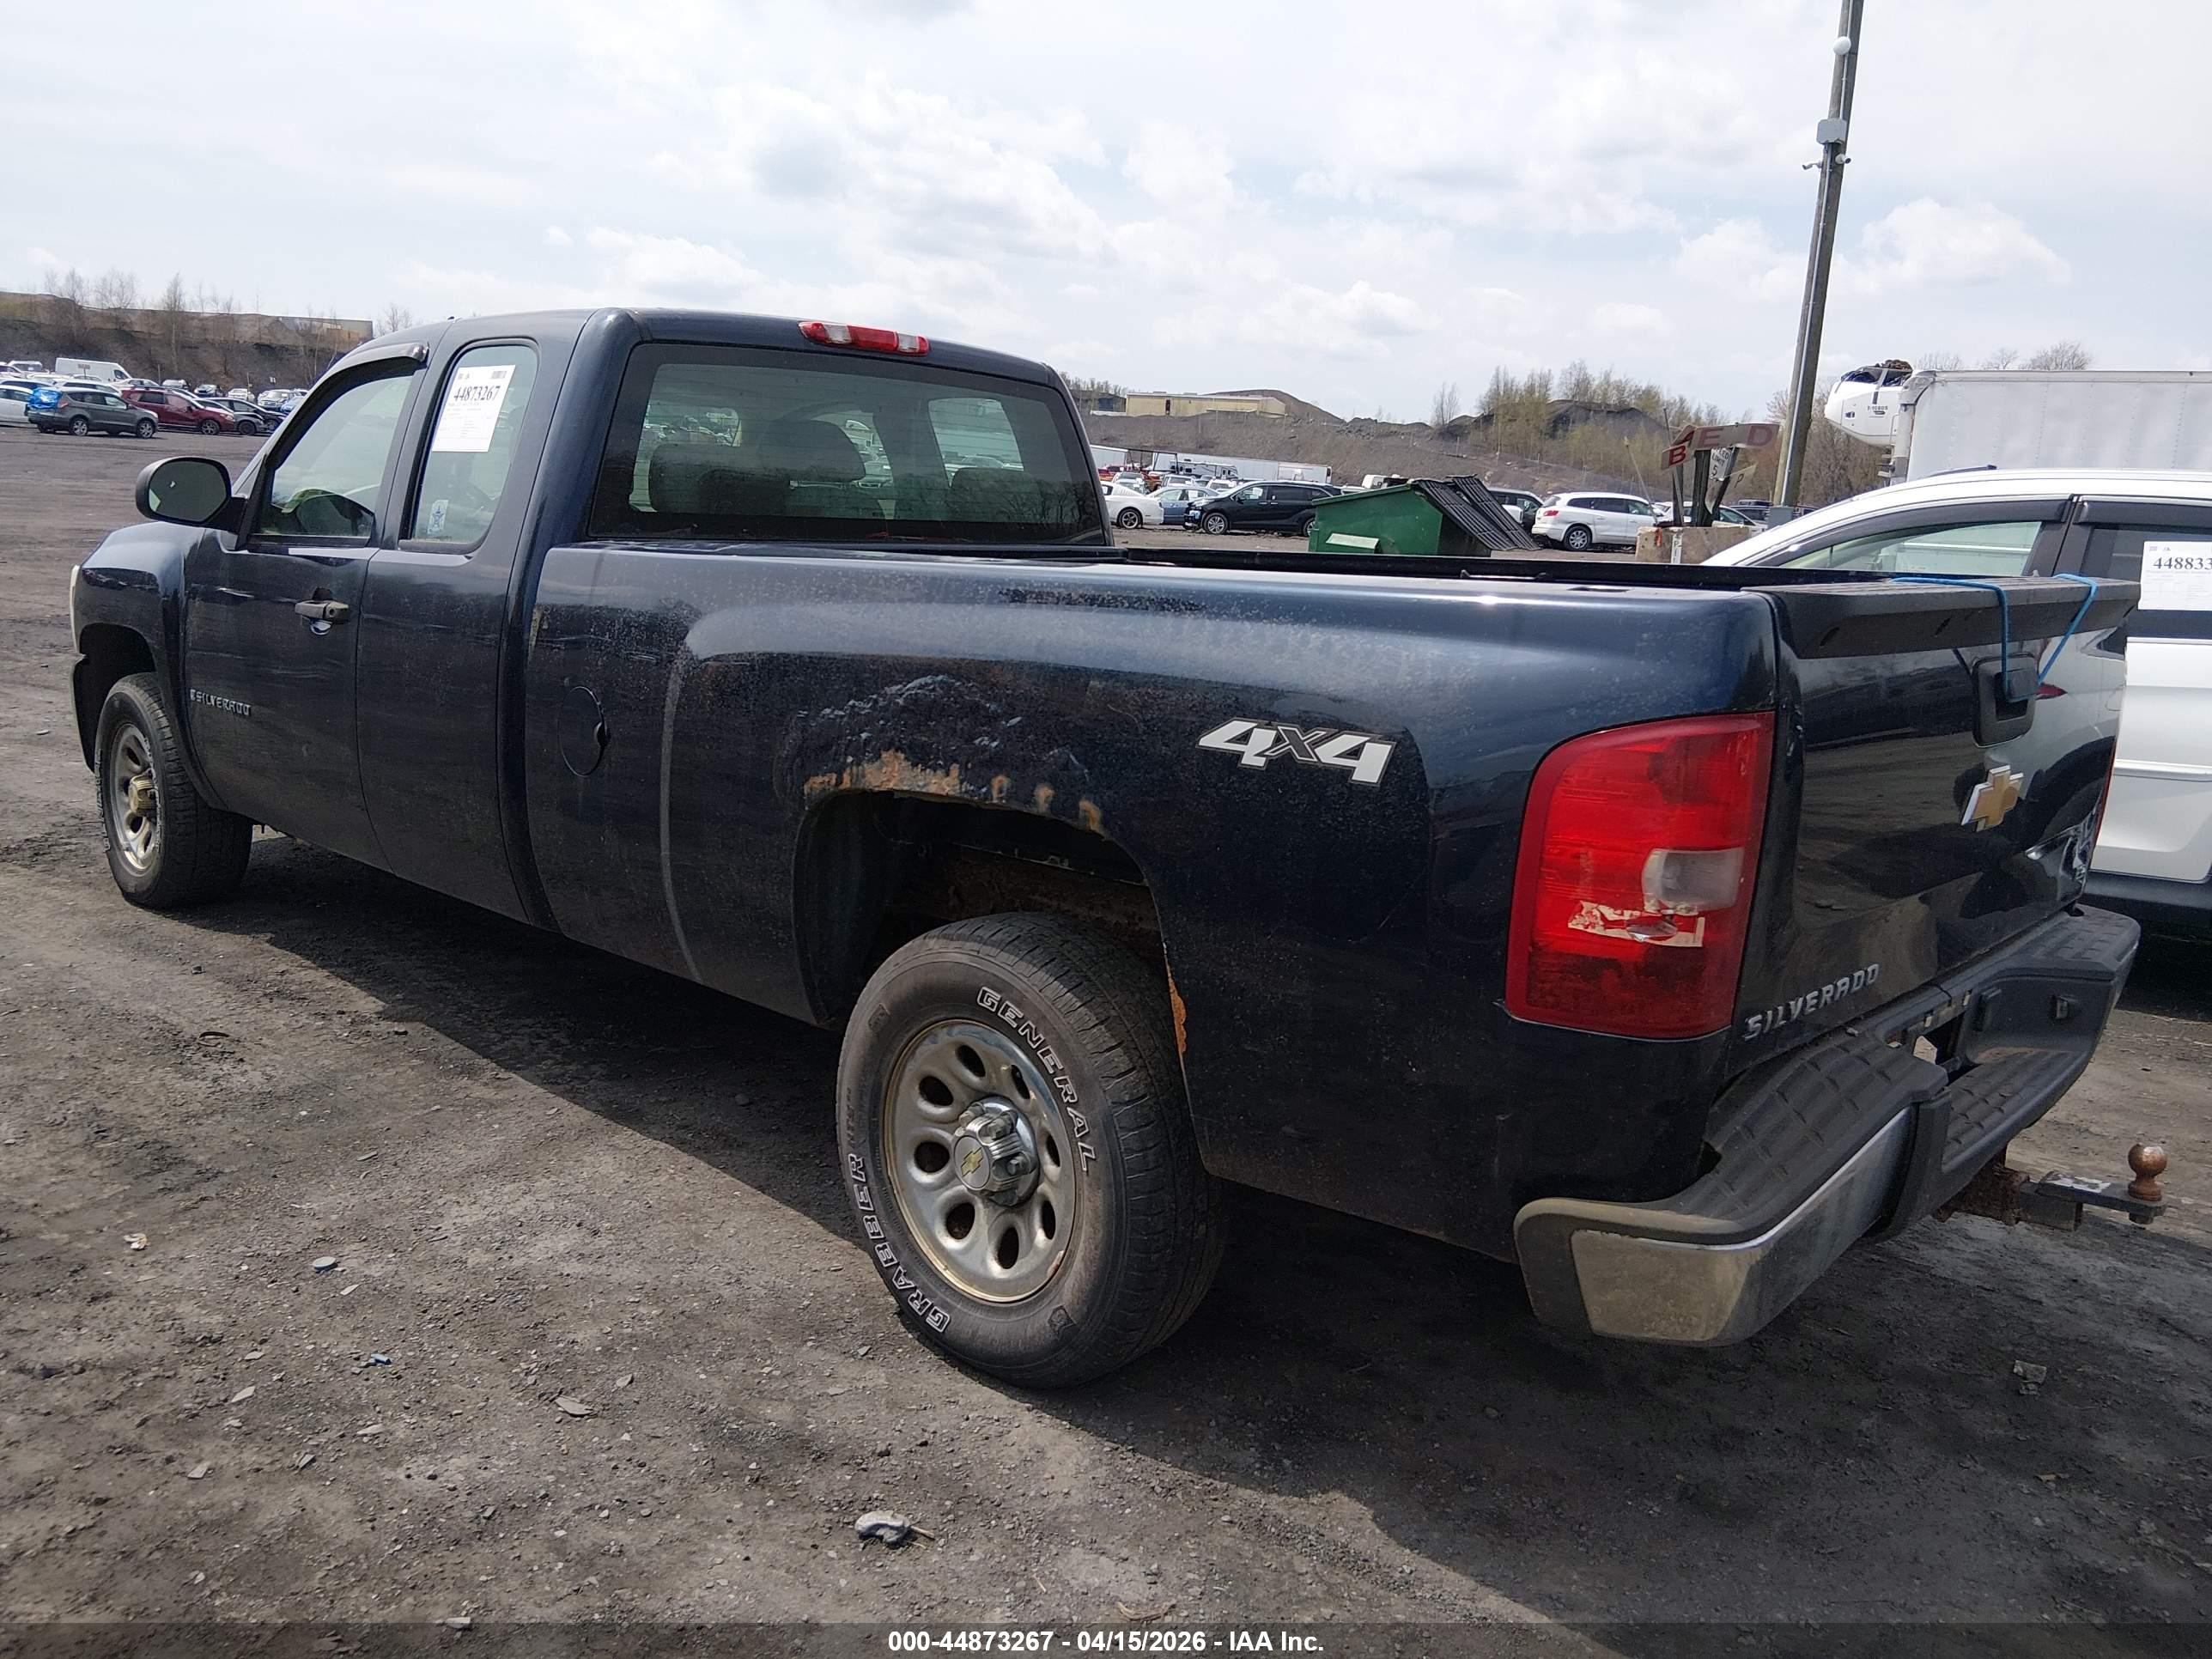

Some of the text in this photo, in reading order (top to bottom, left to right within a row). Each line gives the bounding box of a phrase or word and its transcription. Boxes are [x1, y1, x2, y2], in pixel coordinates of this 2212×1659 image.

[453, 385, 501, 402] 44873267
[1747, 425, 1773, 447] D
[1668, 446, 1686, 466] B
[1711, 465, 1718, 477] 5
[196, 690, 252, 716] SILVERADO
[1741, 963, 1880, 1042] SILVERADO
[976, 987, 1096, 1172] GENERAL
[848, 1153, 951, 1333] GRABBER
